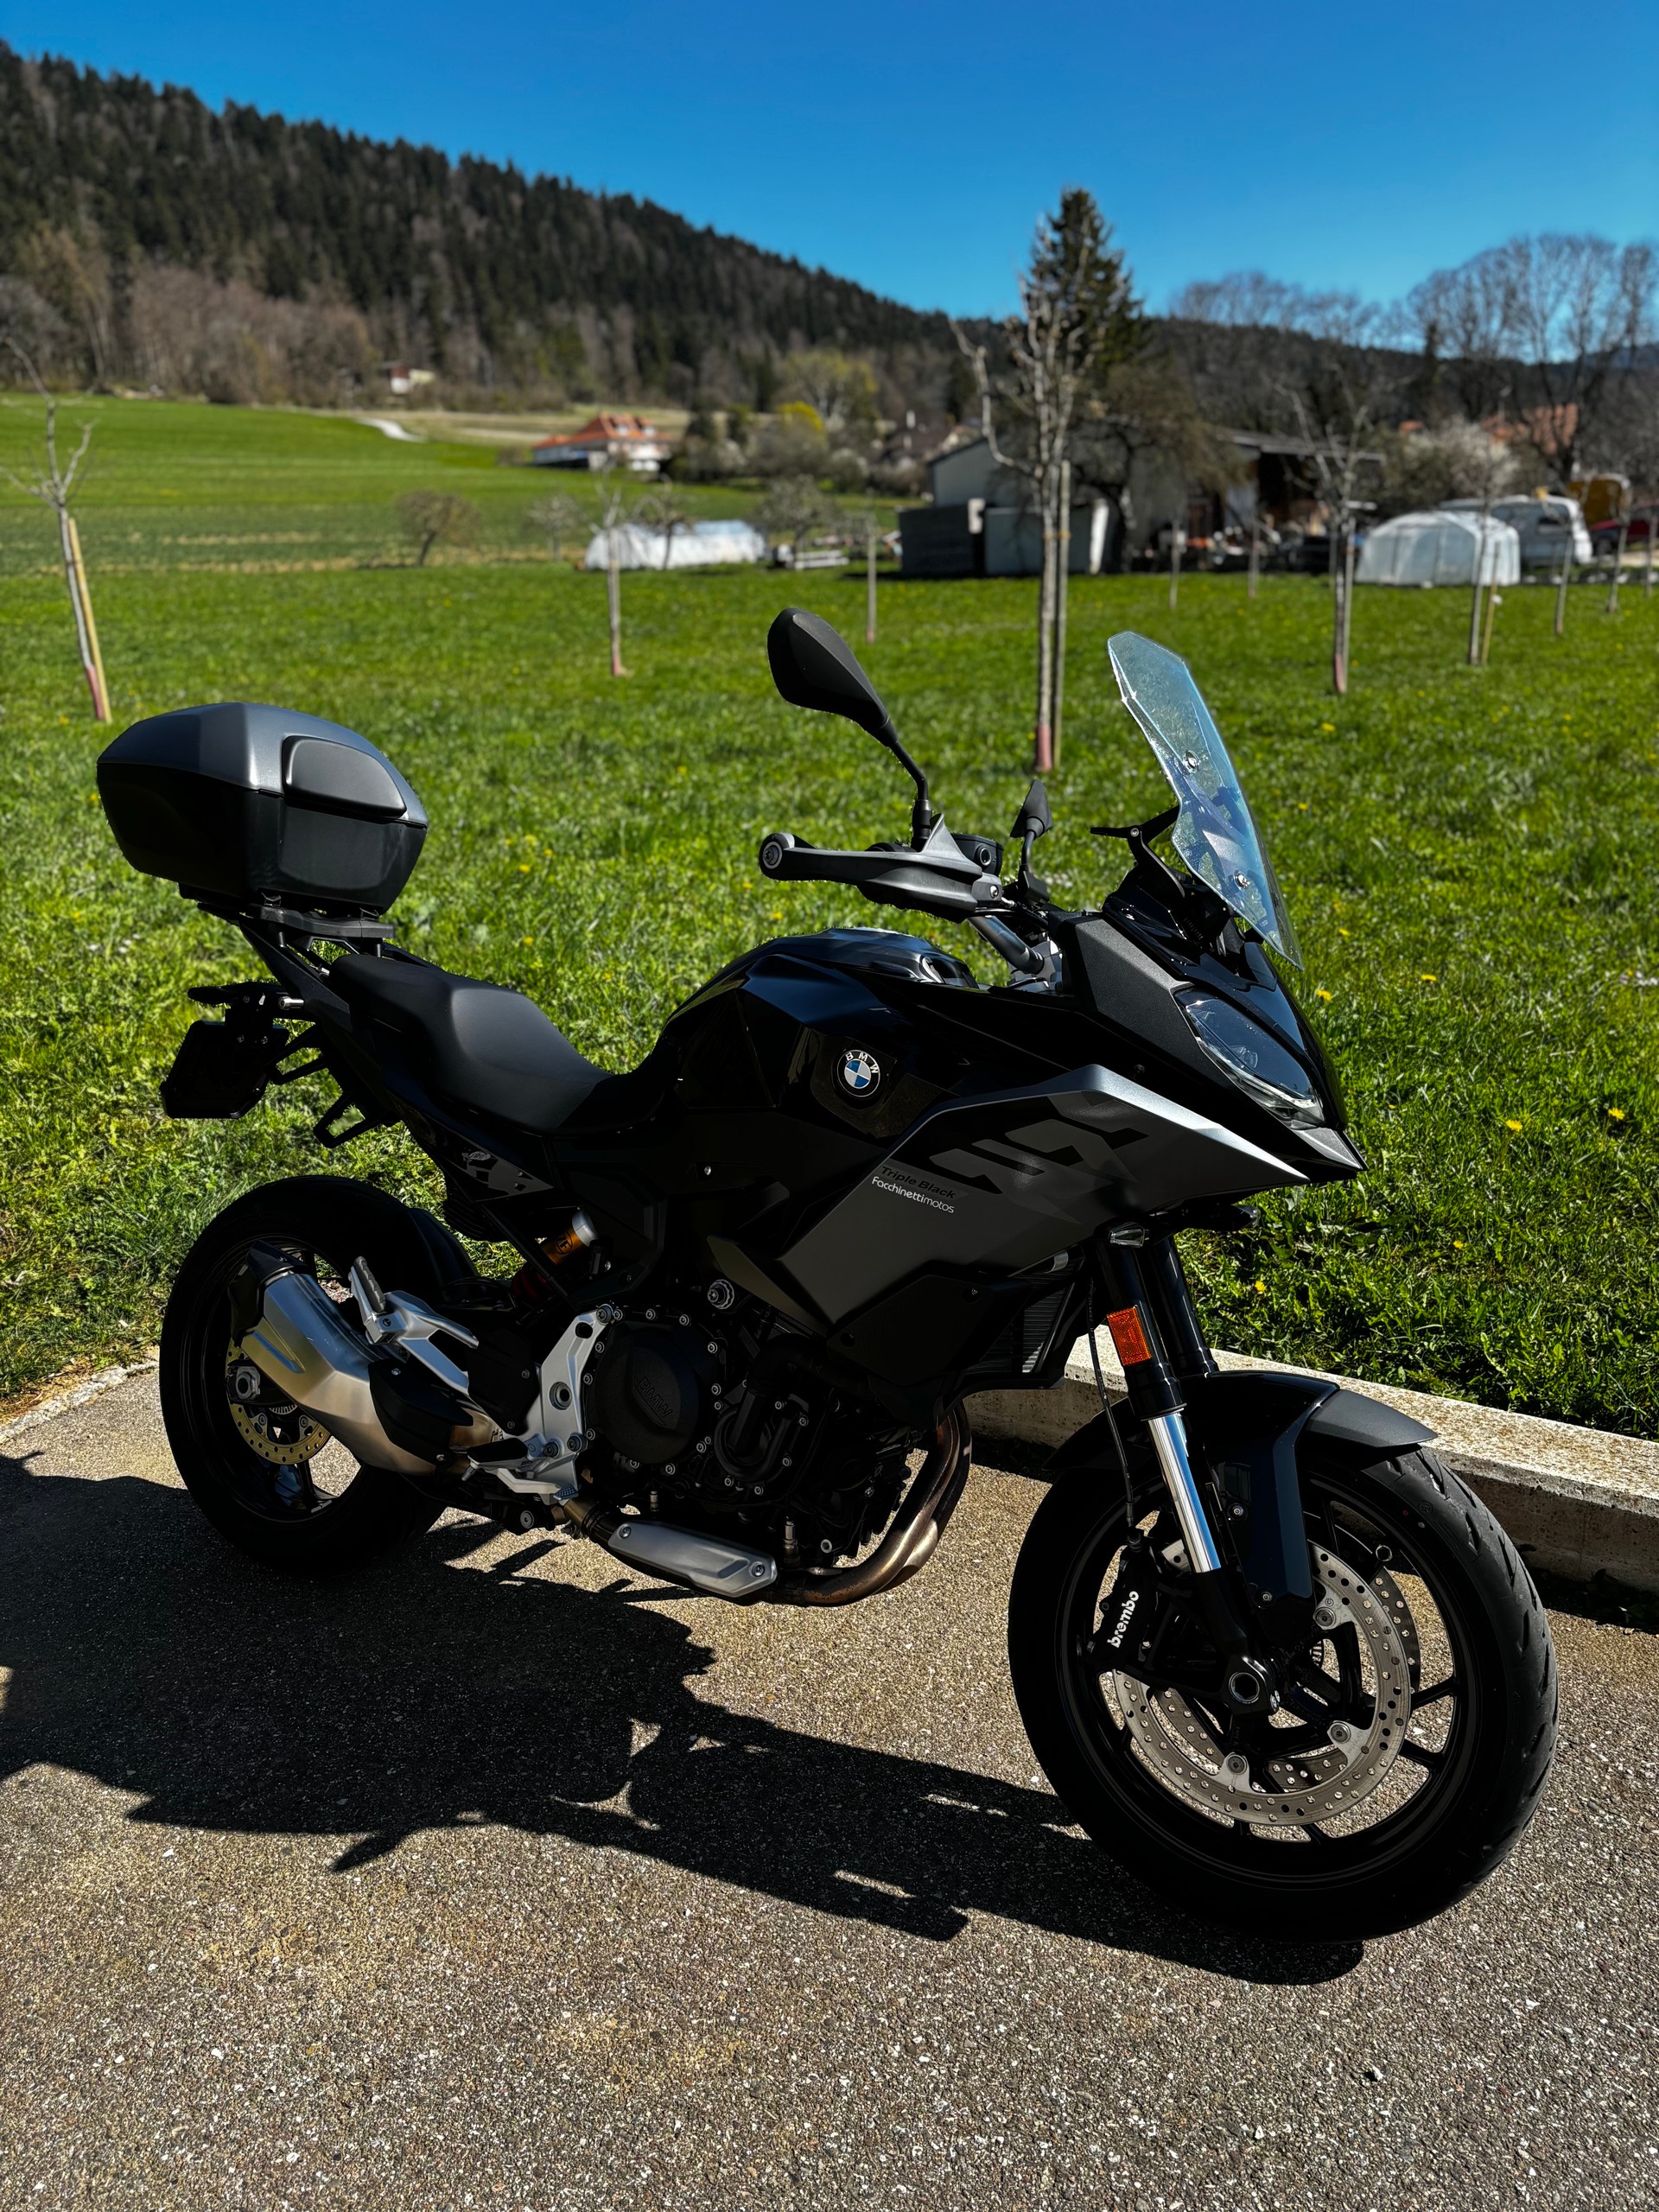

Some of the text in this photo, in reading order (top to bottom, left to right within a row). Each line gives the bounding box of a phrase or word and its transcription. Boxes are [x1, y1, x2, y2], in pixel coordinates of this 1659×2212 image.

[845, 1052, 879, 1074] BMW
[871, 1176, 955, 1213] Facchinettimotos
[882, 1166, 957, 1198] Triple Black
[638, 1376, 673, 1418] BMW
[1106, 1590, 1140, 1649] brembo
